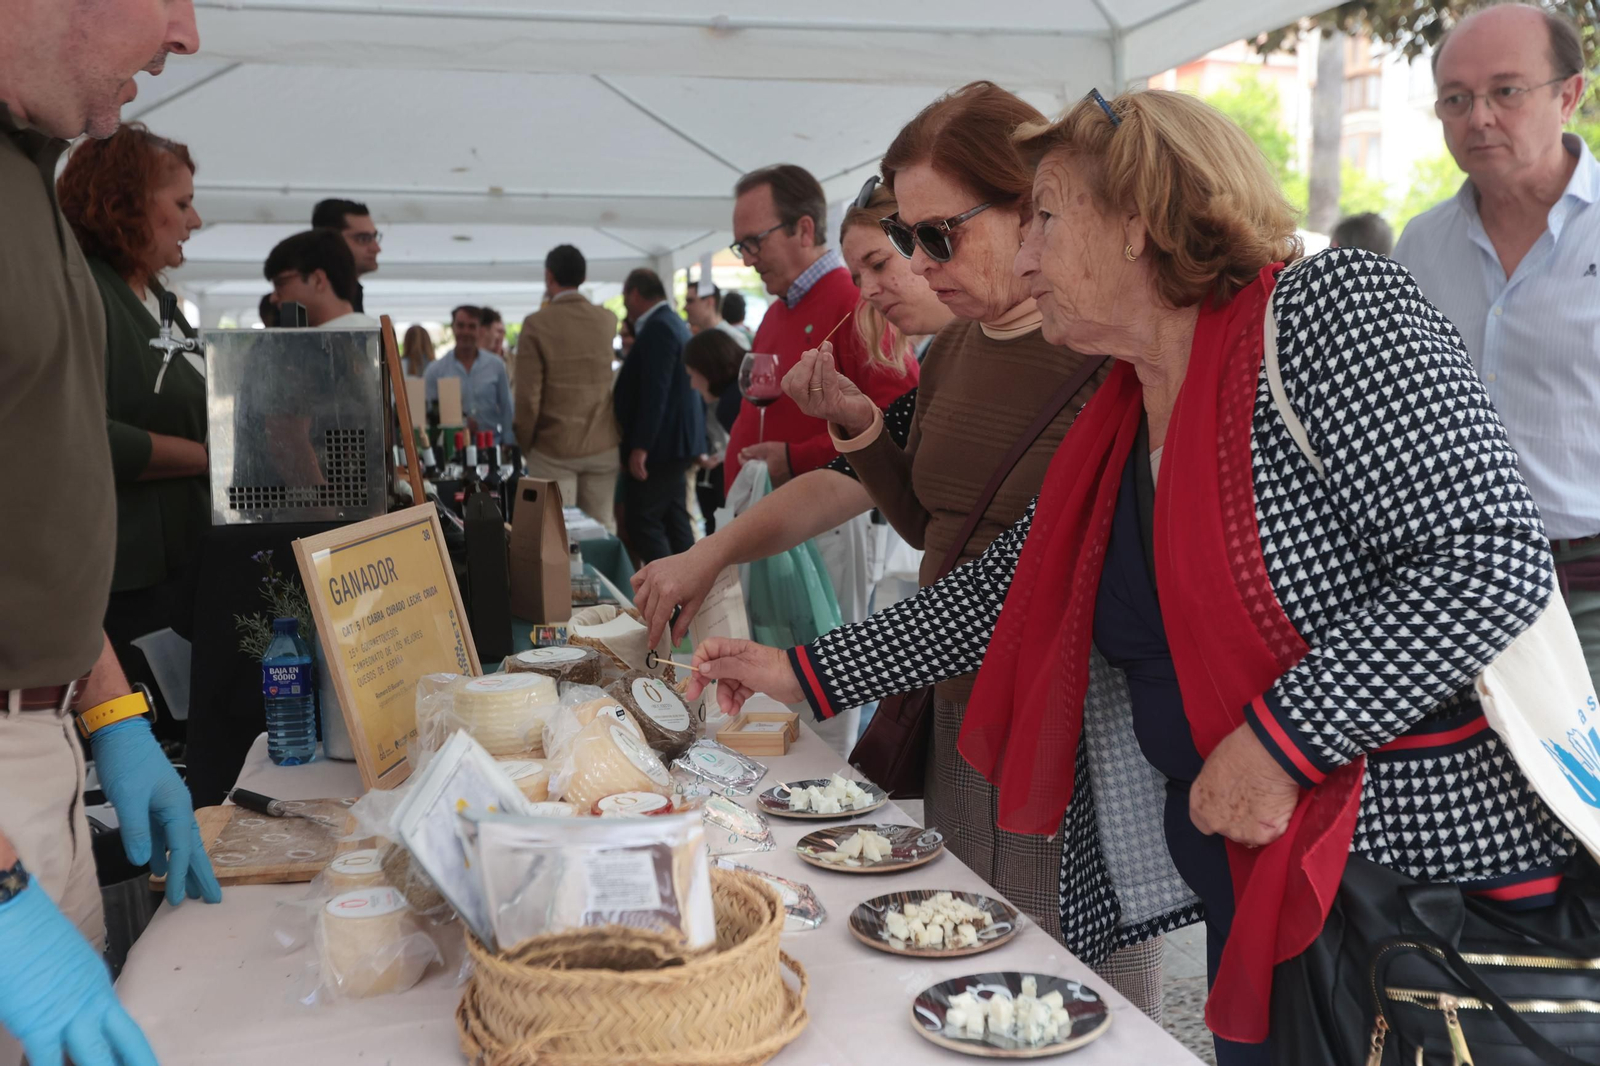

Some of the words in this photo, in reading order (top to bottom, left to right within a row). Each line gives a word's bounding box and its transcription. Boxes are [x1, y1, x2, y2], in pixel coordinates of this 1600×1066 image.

[422, 528, 431, 541] 38
[329, 557, 399, 606] GANADOR
[366, 610, 386, 626] CABRA
[386, 600, 406, 617] CURADO
[406, 592, 423, 607] LECHE
[423, 586, 439, 599] CRUDA
[353, 650, 384, 673] CAMPEONATO
[385, 646, 393, 656] DE
[394, 640, 403, 652] LOS
[404, 629, 424, 646] MEJORES
[269, 667, 288, 675] BAJA
[357, 669, 377, 688] QUESOS
[378, 665, 385, 676] DE
[386, 654, 404, 671] ESPAÑA
